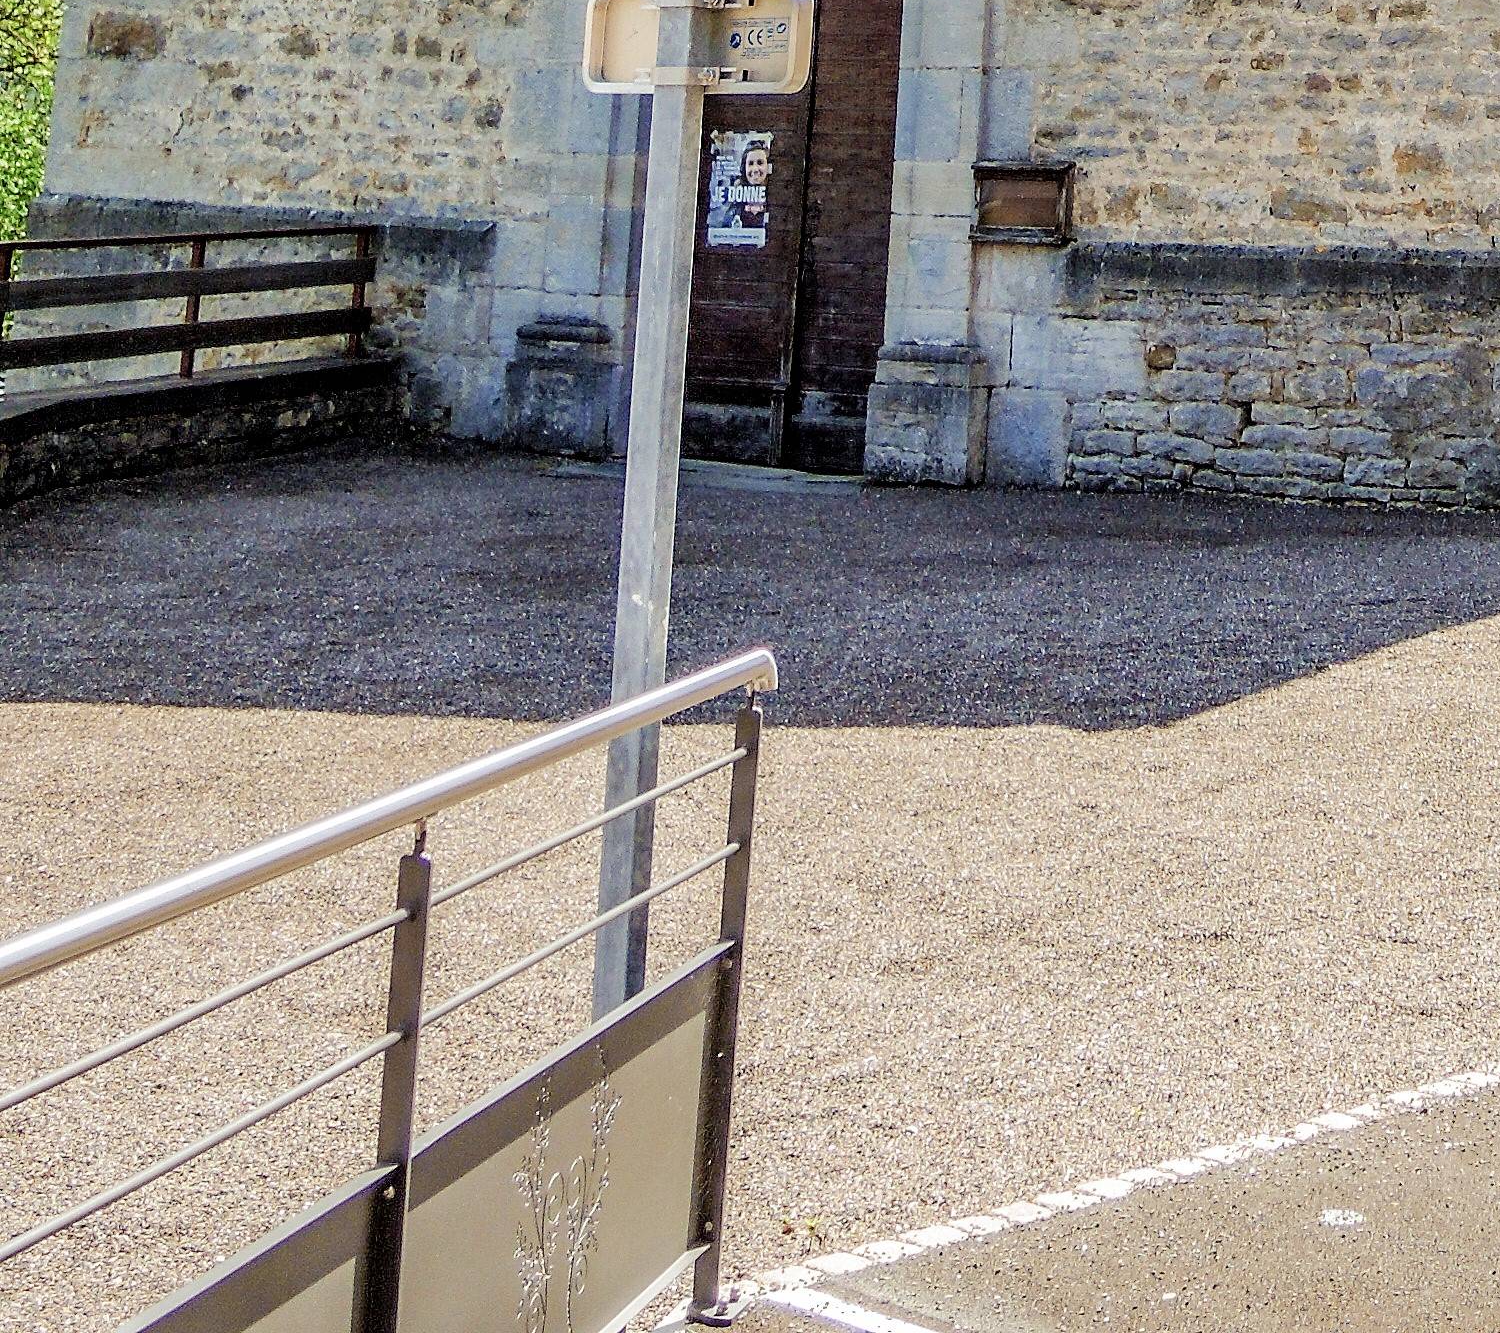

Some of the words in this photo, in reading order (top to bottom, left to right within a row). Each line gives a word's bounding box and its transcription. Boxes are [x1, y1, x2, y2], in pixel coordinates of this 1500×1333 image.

[748, 29, 763, 45] CE
[713, 186, 726, 202] JE
[728, 186, 766, 203] DONNE
